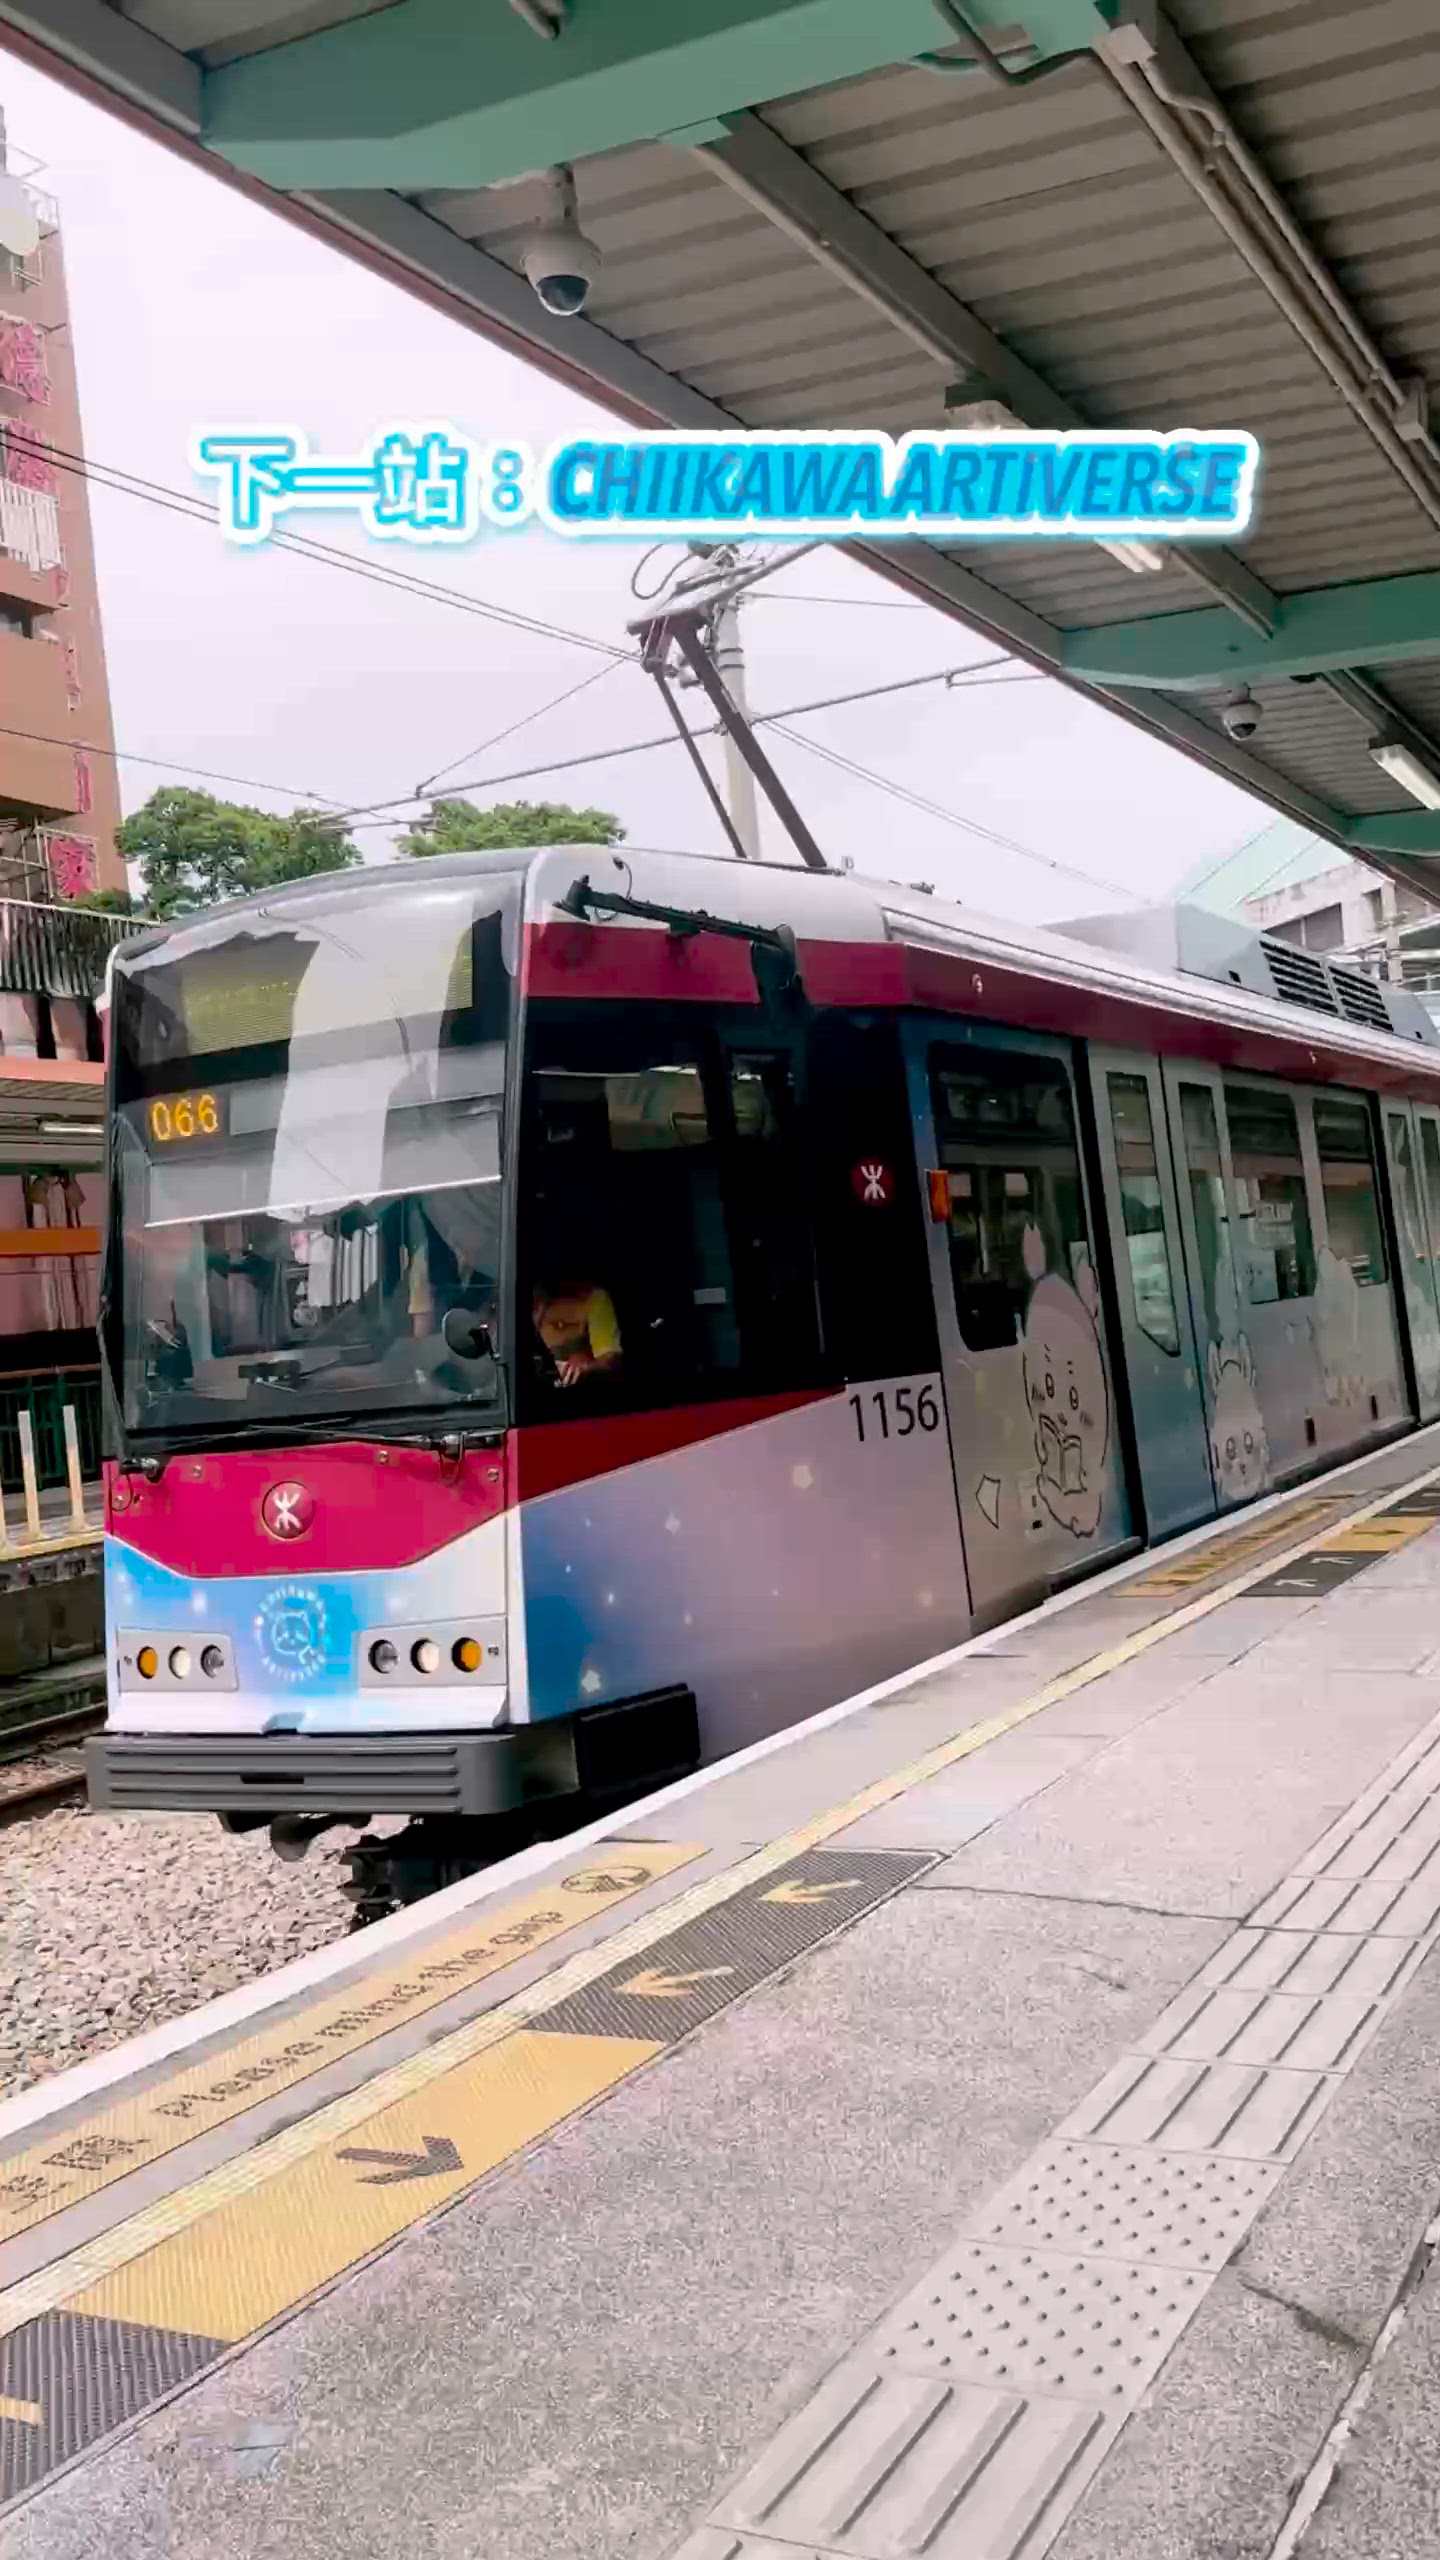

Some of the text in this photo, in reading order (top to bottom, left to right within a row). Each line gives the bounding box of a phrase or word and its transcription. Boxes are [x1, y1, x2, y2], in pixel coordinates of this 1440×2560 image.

[152, 1093, 219, 1140] 066
[849, 1384, 938, 1442] 1156
[153, 2041, 325, 2118] Please
[314, 1983, 433, 2038] mind
[417, 1948, 496, 1980] the
[489, 1911, 564, 1945] gap
